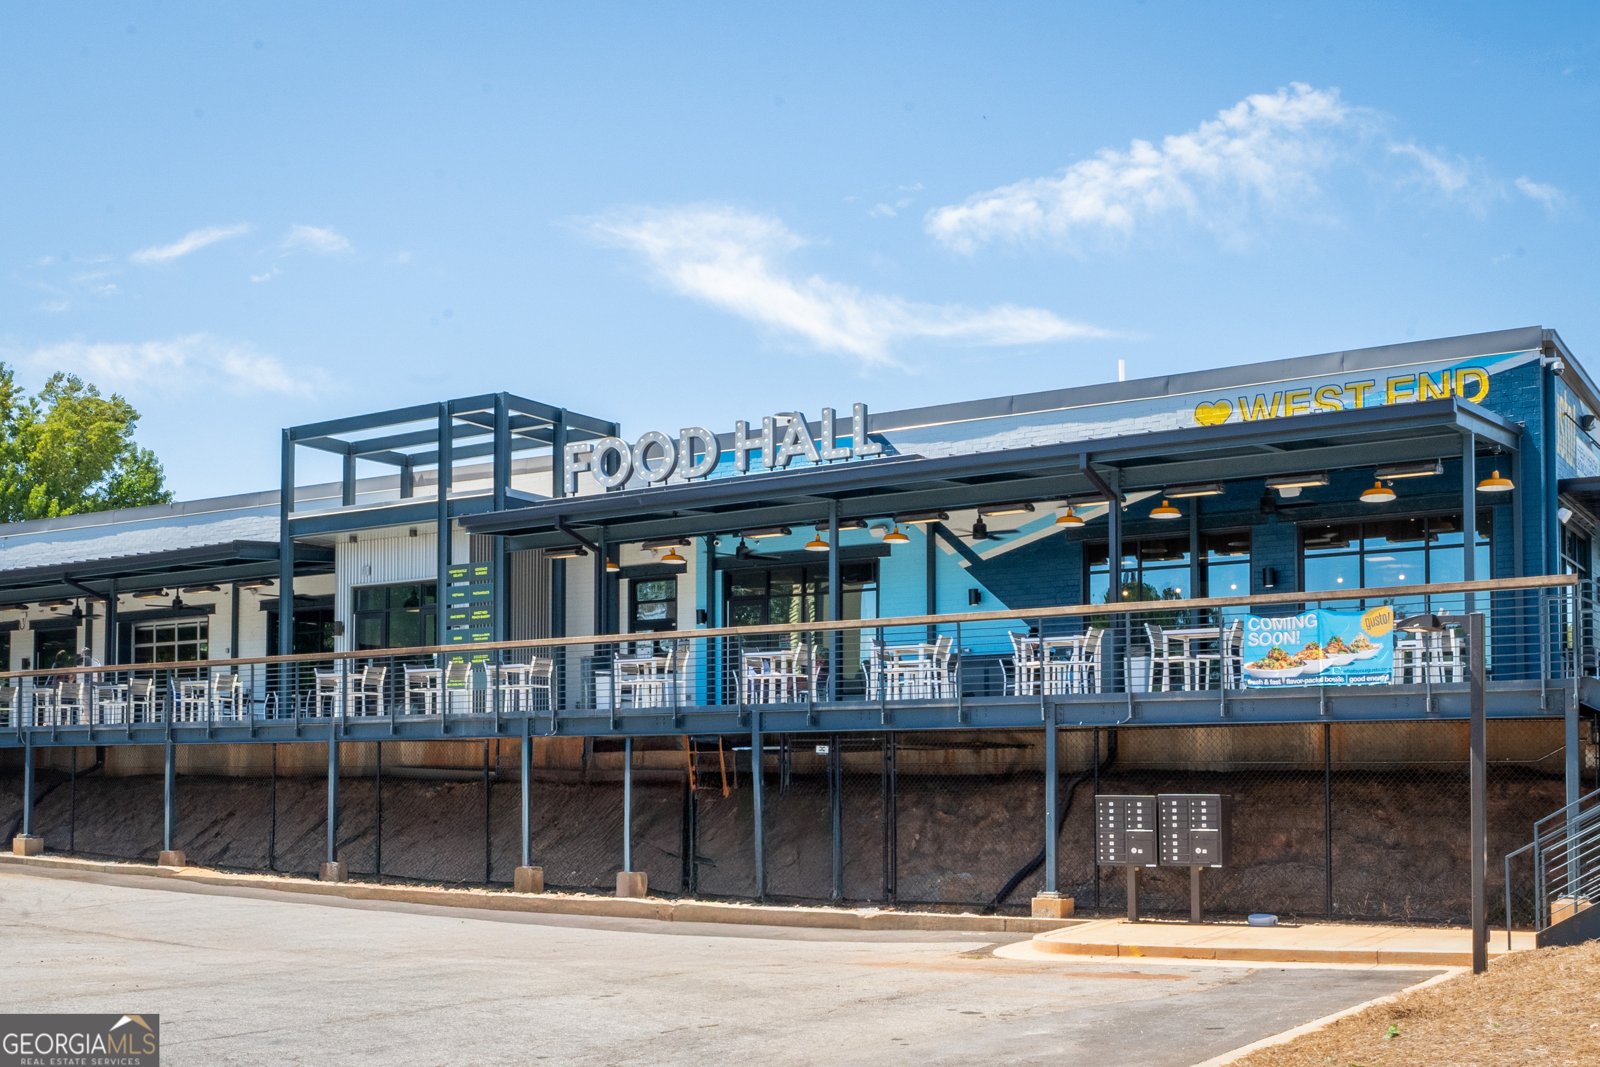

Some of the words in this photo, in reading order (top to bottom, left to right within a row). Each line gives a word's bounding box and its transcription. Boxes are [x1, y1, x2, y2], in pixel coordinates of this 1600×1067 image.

[1238, 379, 1375, 422] WEST
[1385, 366, 1490, 405] END
[564, 426, 720, 494] FOOD
[735, 402, 882, 471] HALL
[1248, 613, 1317, 631] COMING
[1365, 611, 1391, 631] gusto!
[1248, 630, 1300, 647] SOON!
[1349, 674, 1366, 684] good
